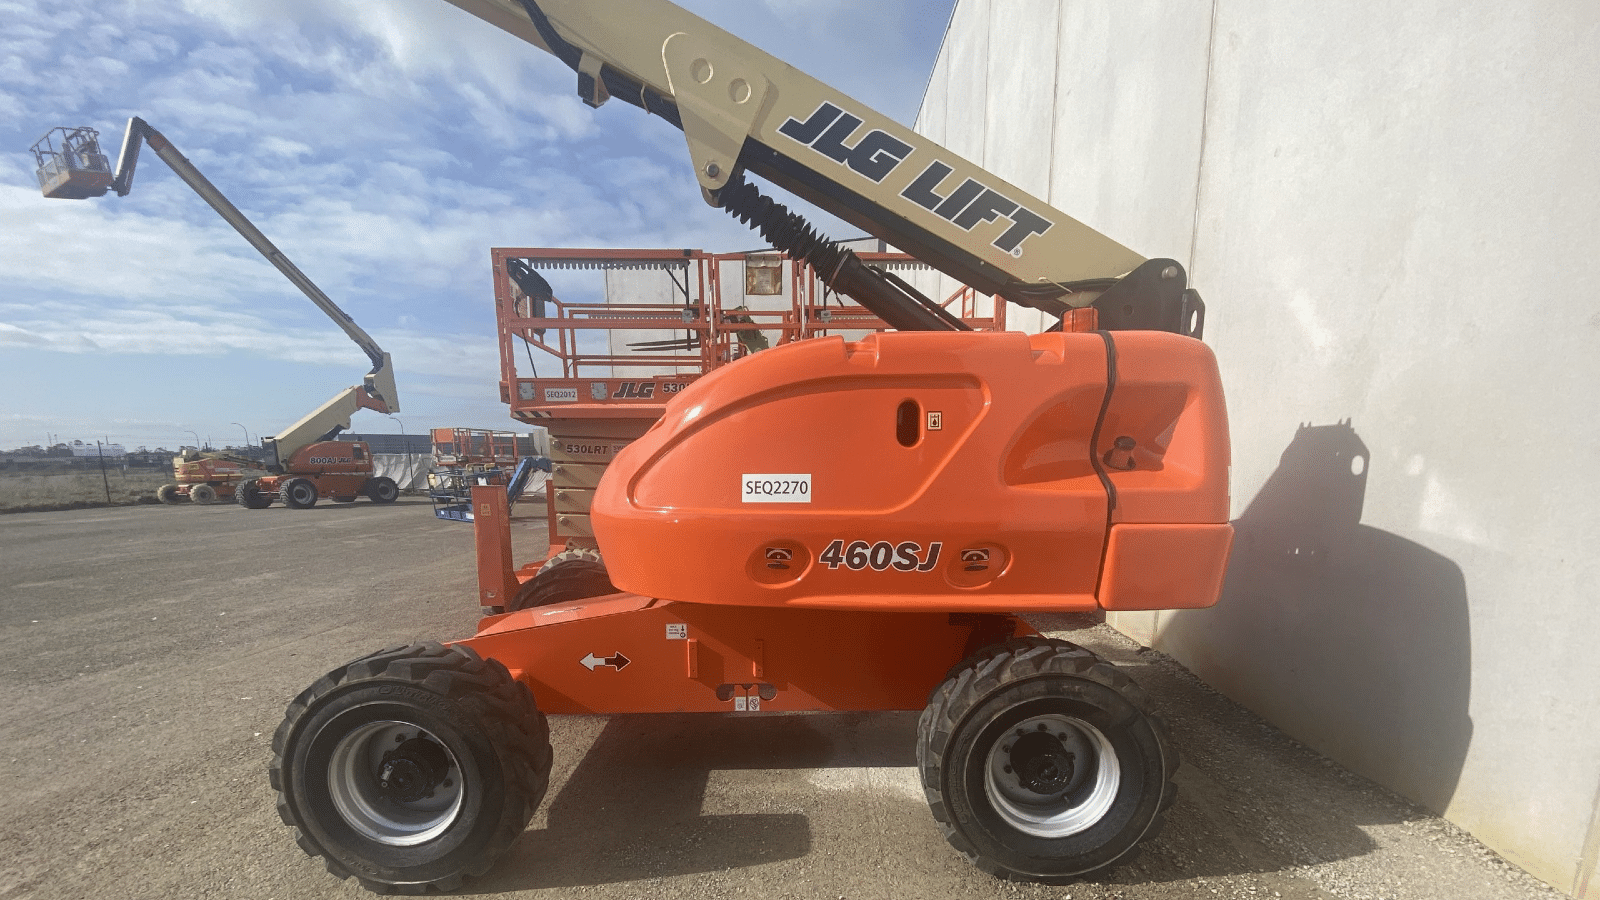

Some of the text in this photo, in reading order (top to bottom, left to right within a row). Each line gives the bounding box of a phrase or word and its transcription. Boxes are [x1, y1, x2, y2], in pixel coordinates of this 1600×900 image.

[776, 100, 1055, 254] JLG LIFT
[546, 391, 576, 399] SEQ2012
[611, 381, 690, 400] JLG 530
[566, 443, 608, 455] 530LRT
[309, 456, 338, 464] 800AJ
[745, 480, 809, 496] SEQ2270
[819, 539, 943, 573] 460SJ
